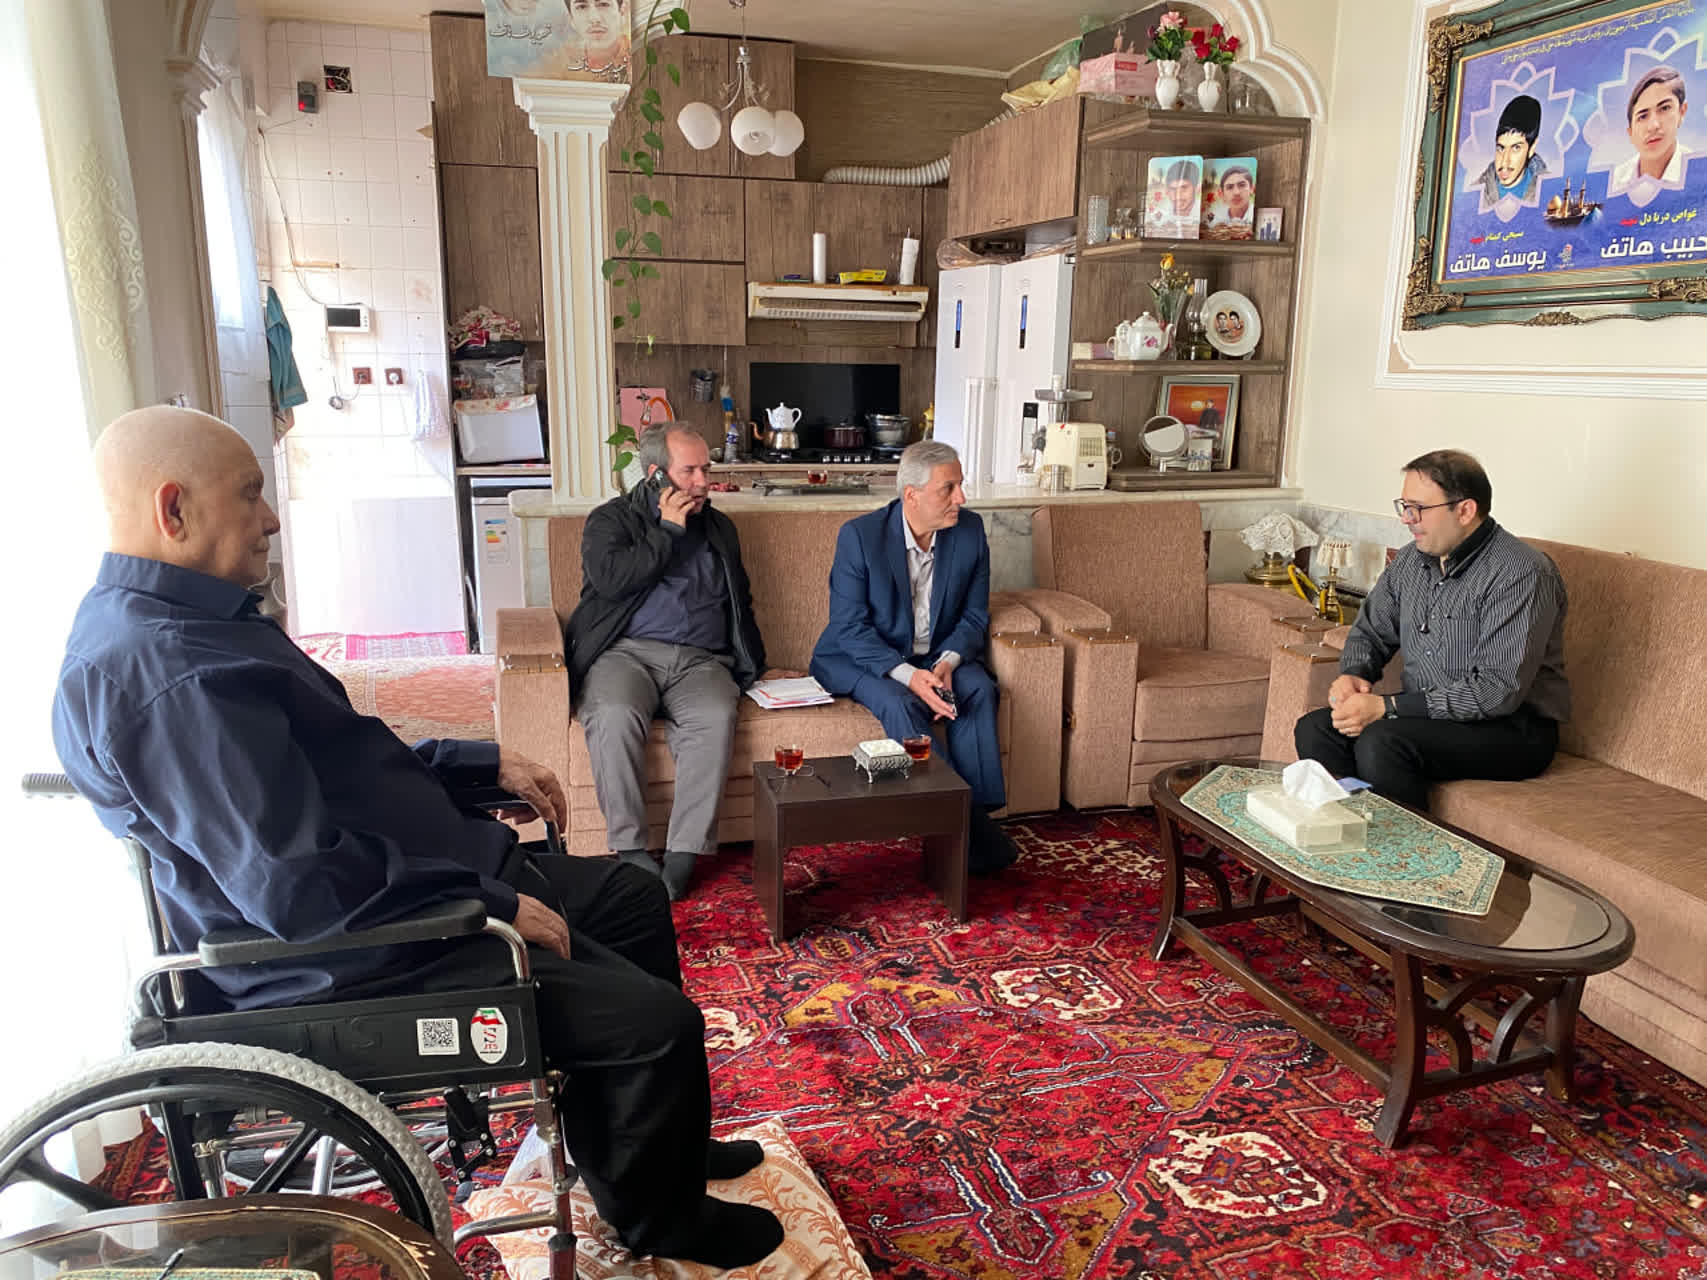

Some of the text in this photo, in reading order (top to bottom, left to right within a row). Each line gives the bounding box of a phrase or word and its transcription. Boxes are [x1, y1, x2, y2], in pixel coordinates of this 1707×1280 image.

[1600, 236, 1707, 259] حبیب هاتف
[1450, 249, 1546, 273] یوسف هاتف
